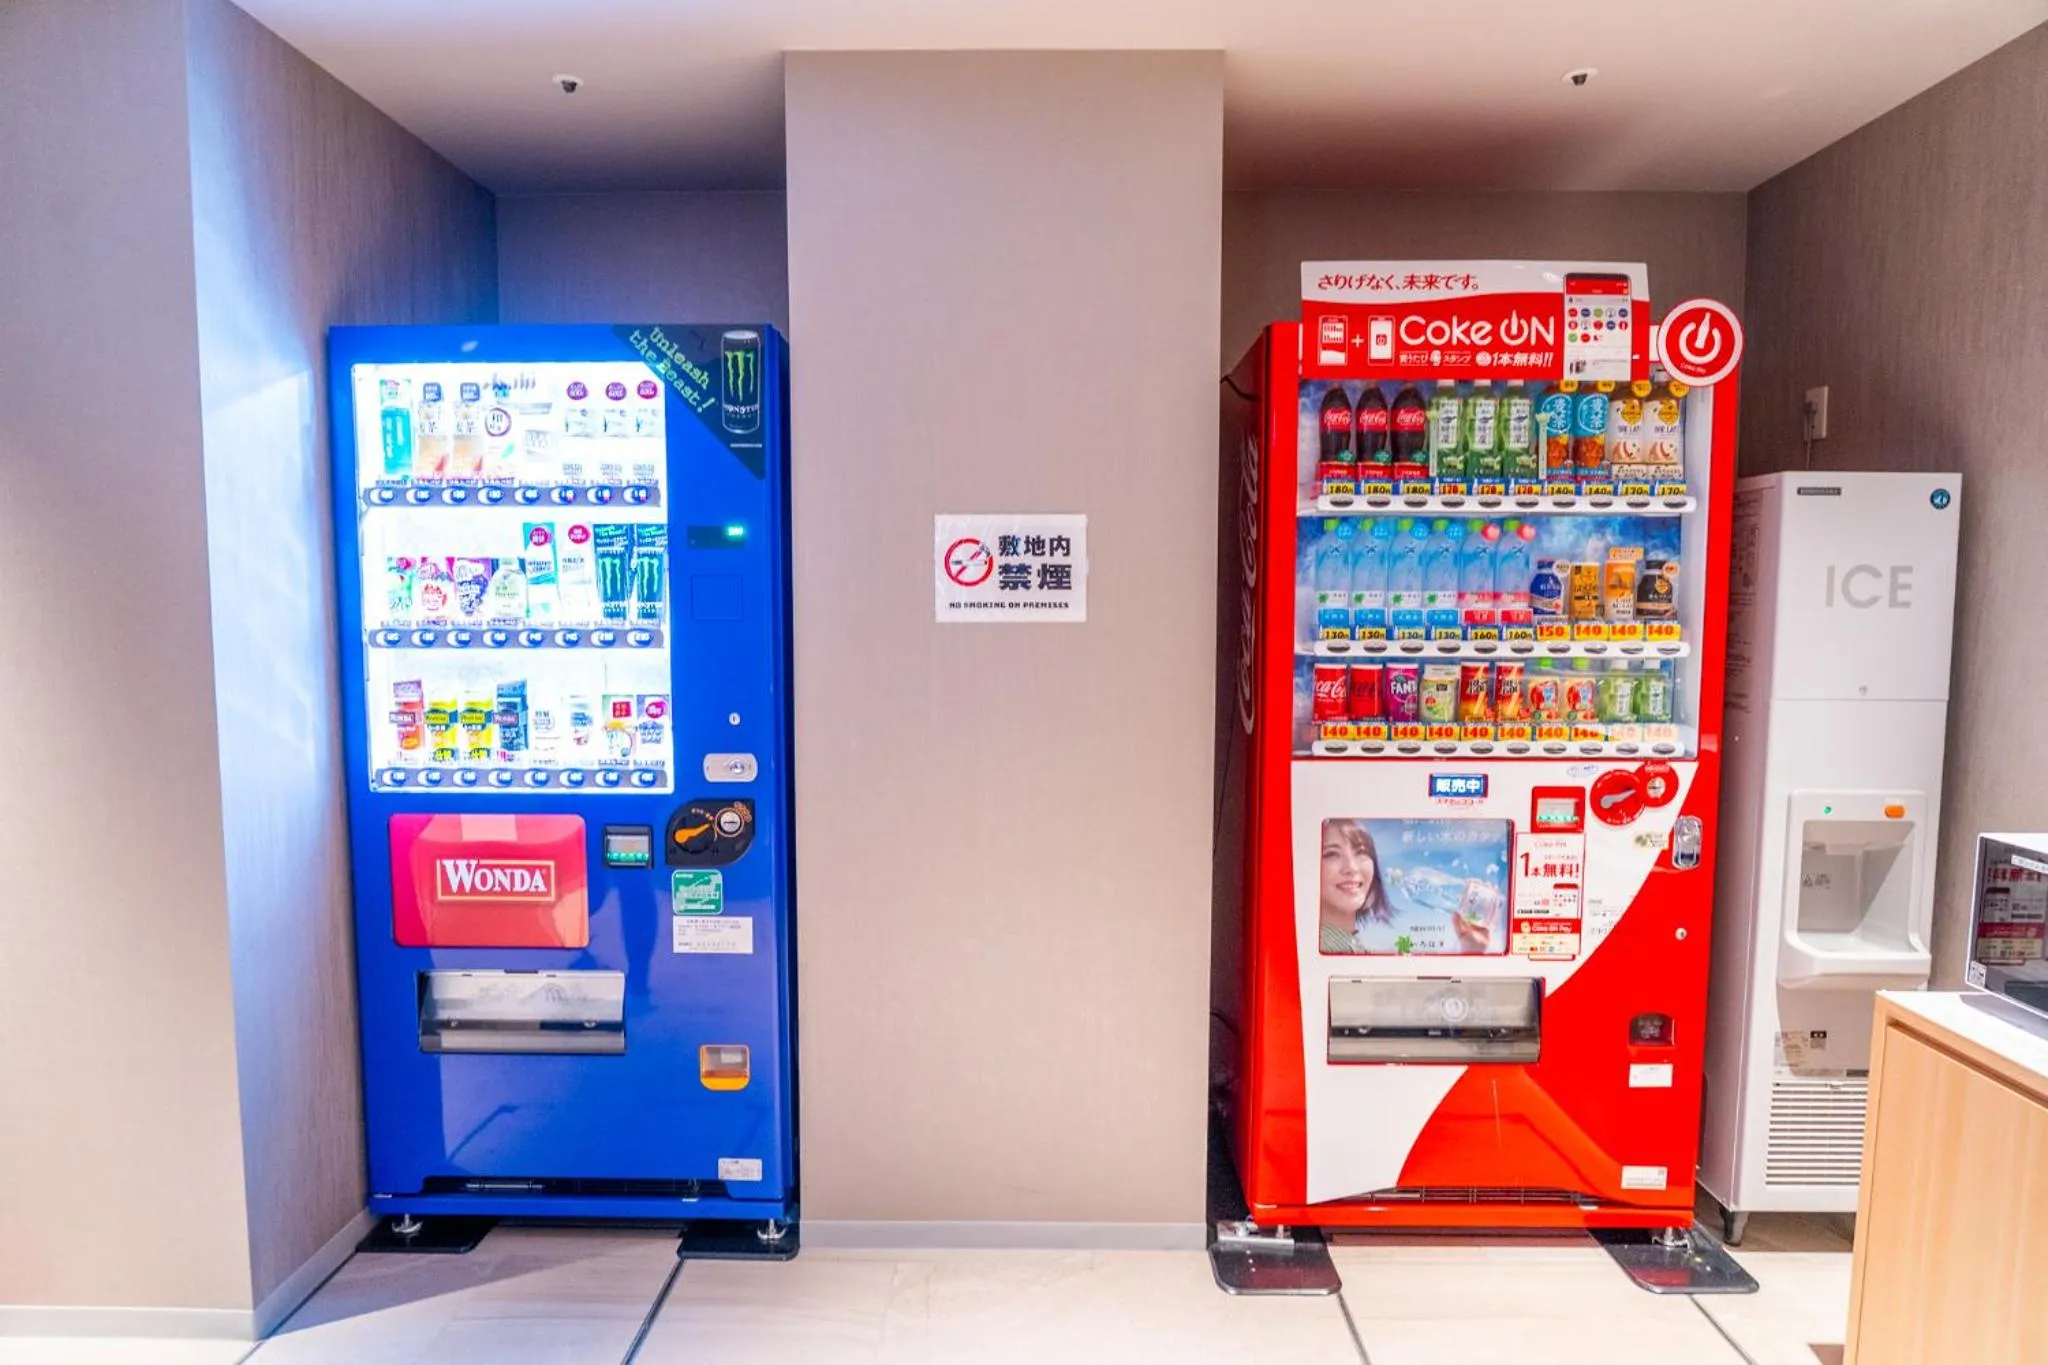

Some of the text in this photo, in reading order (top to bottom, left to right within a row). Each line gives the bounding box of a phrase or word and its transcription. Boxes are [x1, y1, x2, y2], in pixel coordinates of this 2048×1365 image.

[1318, 273, 1479, 291] さりげなく、未来です。
[1400, 309, 1555, 347] Coke ON
[629, 329, 716, 413] the Beast!
[650, 327, 710, 390] Unleash
[998, 535, 1071, 557] 敷地内
[998, 563, 1073, 590] 禁煙
[1825, 564, 1914, 609] ICE
[949, 601, 1069, 609] NO SMOKING ON PREMISES
[442, 859, 548, 893] WONDA
